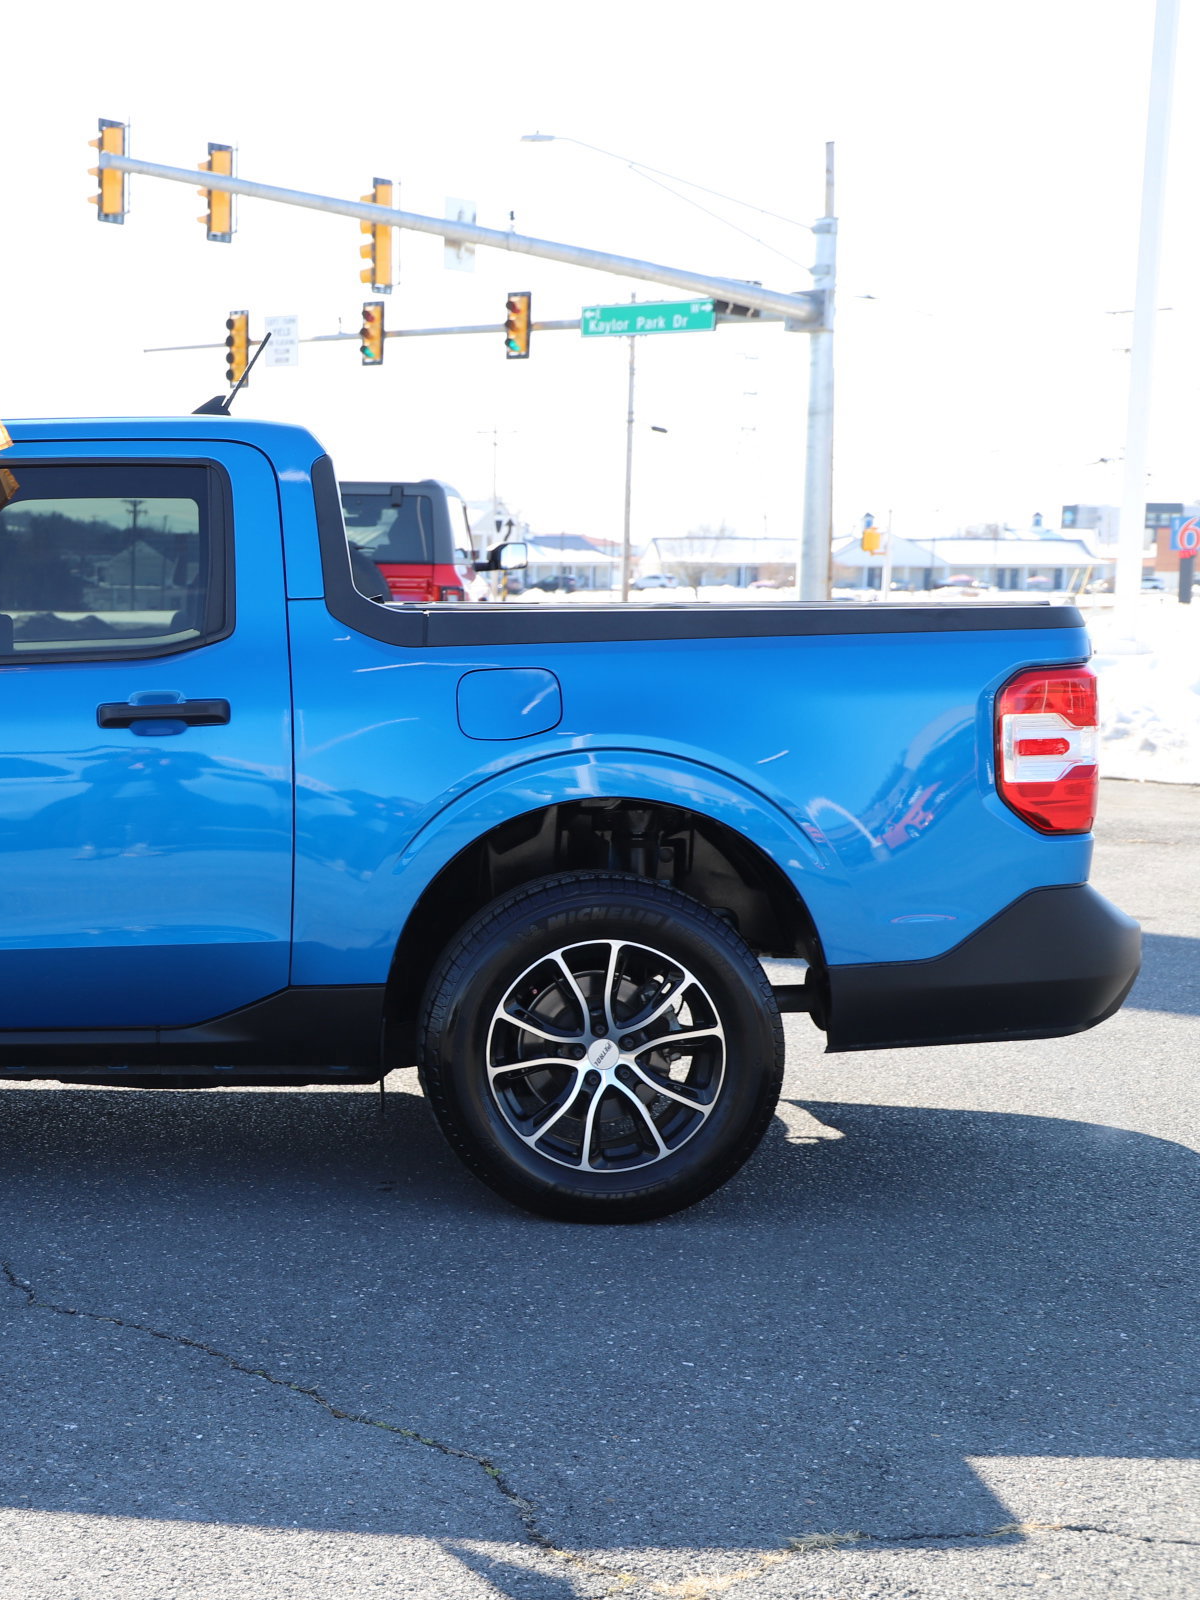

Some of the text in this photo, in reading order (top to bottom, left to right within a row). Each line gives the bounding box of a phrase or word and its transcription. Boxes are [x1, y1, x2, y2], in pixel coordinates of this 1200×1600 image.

[588, 314, 688, 334] Kaylor Park Dr
[1178, 516, 1200, 550] 6
[547, 904, 665, 931] MICHELIN
[594, 1041, 614, 1067] PETROL
